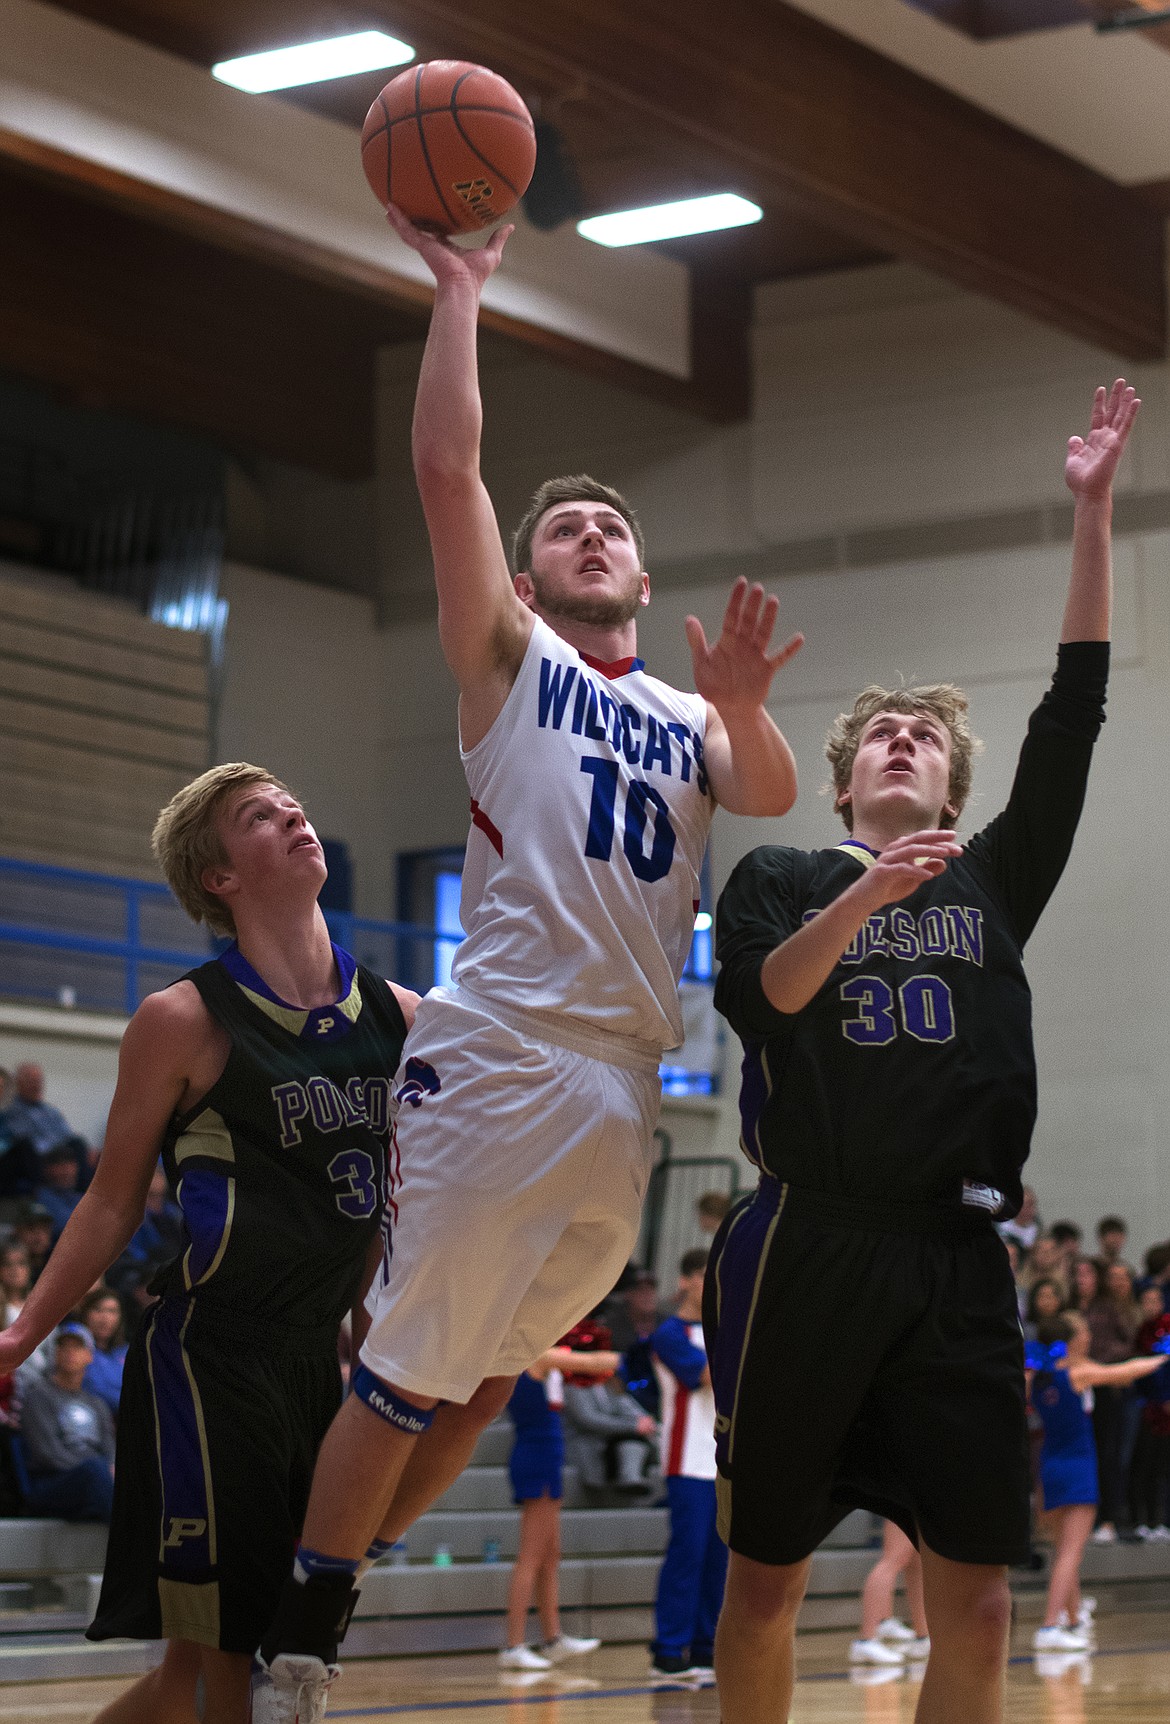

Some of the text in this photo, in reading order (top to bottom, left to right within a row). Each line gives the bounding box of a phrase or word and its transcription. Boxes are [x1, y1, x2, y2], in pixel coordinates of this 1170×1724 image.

[538, 657, 707, 796] WILDCATS
[580, 755, 677, 884] 10
[317, 1016, 335, 1034] P
[840, 974, 956, 1046] 30
[271, 1076, 392, 1148] POLSO
[327, 1149, 387, 1219] 3
[374, 1394, 426, 1432] Mueller
[163, 1517, 207, 1547] P
